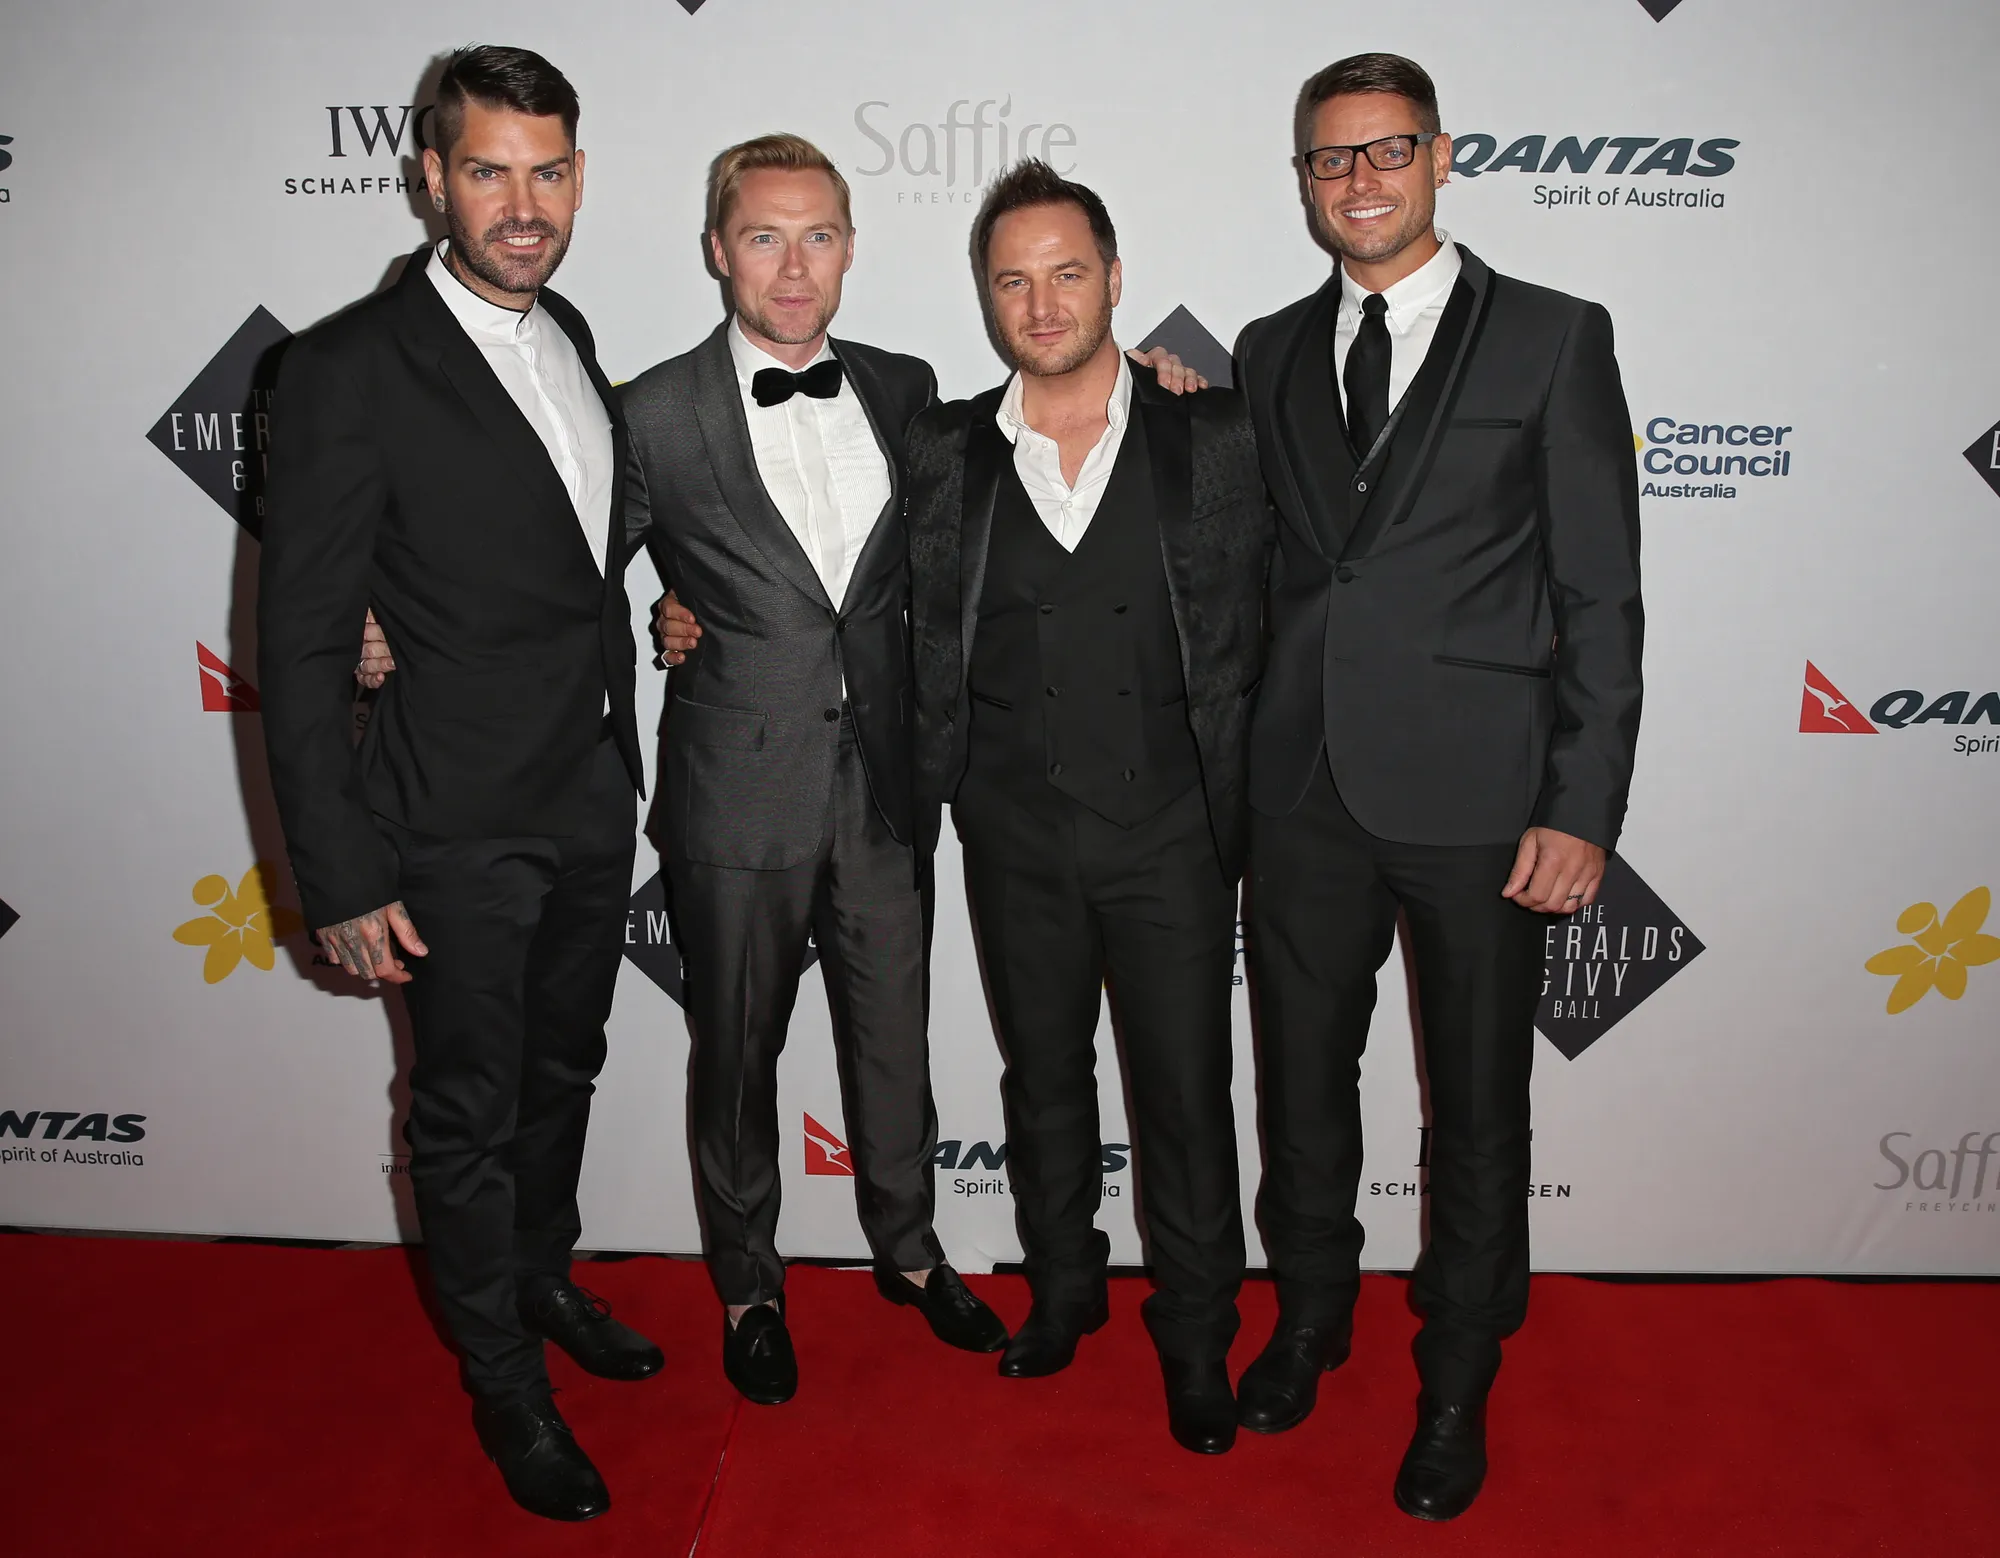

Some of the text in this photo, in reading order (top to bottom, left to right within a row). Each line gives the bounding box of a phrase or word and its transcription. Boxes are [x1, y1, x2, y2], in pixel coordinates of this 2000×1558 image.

[854, 93, 1078, 188] Saffire
[1449, 133, 1741, 178] QANTAS
[1533, 185, 1725, 209] Spirit of Australia
[1646, 417, 1793, 446] Cancer
[1643, 447, 1790, 477] Council
[1641, 482, 1737, 499] Australia
[1565, 962, 1629, 997] IVY
[1553, 1000, 1601, 1019] BALL
[0, 1146, 145, 1166] pirit of Australia
[1873, 1131, 2000, 1200] Saff
[953, 1178, 1004, 1198] Spirit
